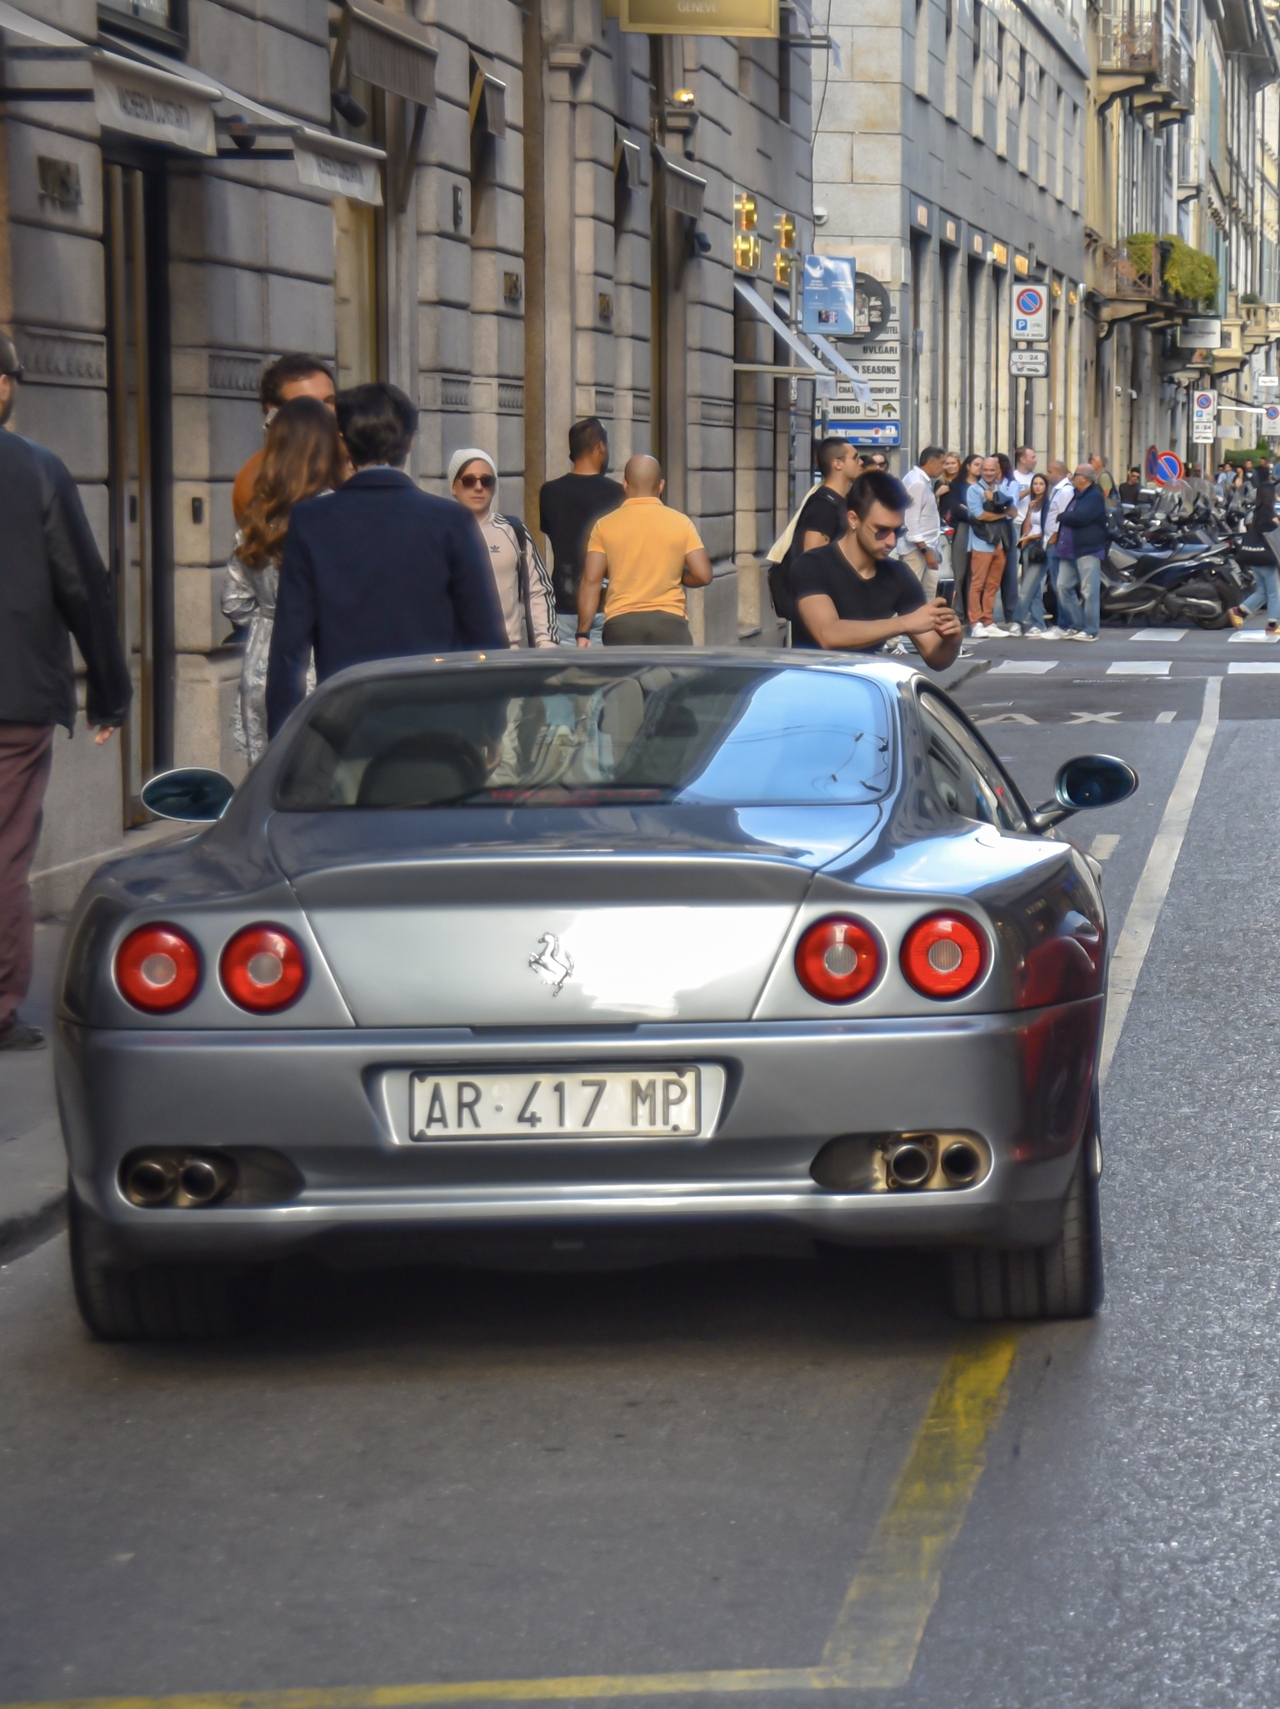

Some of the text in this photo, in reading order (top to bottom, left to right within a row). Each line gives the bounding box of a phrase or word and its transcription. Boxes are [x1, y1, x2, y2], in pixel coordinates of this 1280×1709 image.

[862, 346, 898, 354] BVLGARI
[862, 365, 897, 374] SEASONS
[832, 405, 861, 414] INDIGO
[425, 1078, 689, 1129] AR 417 MP
